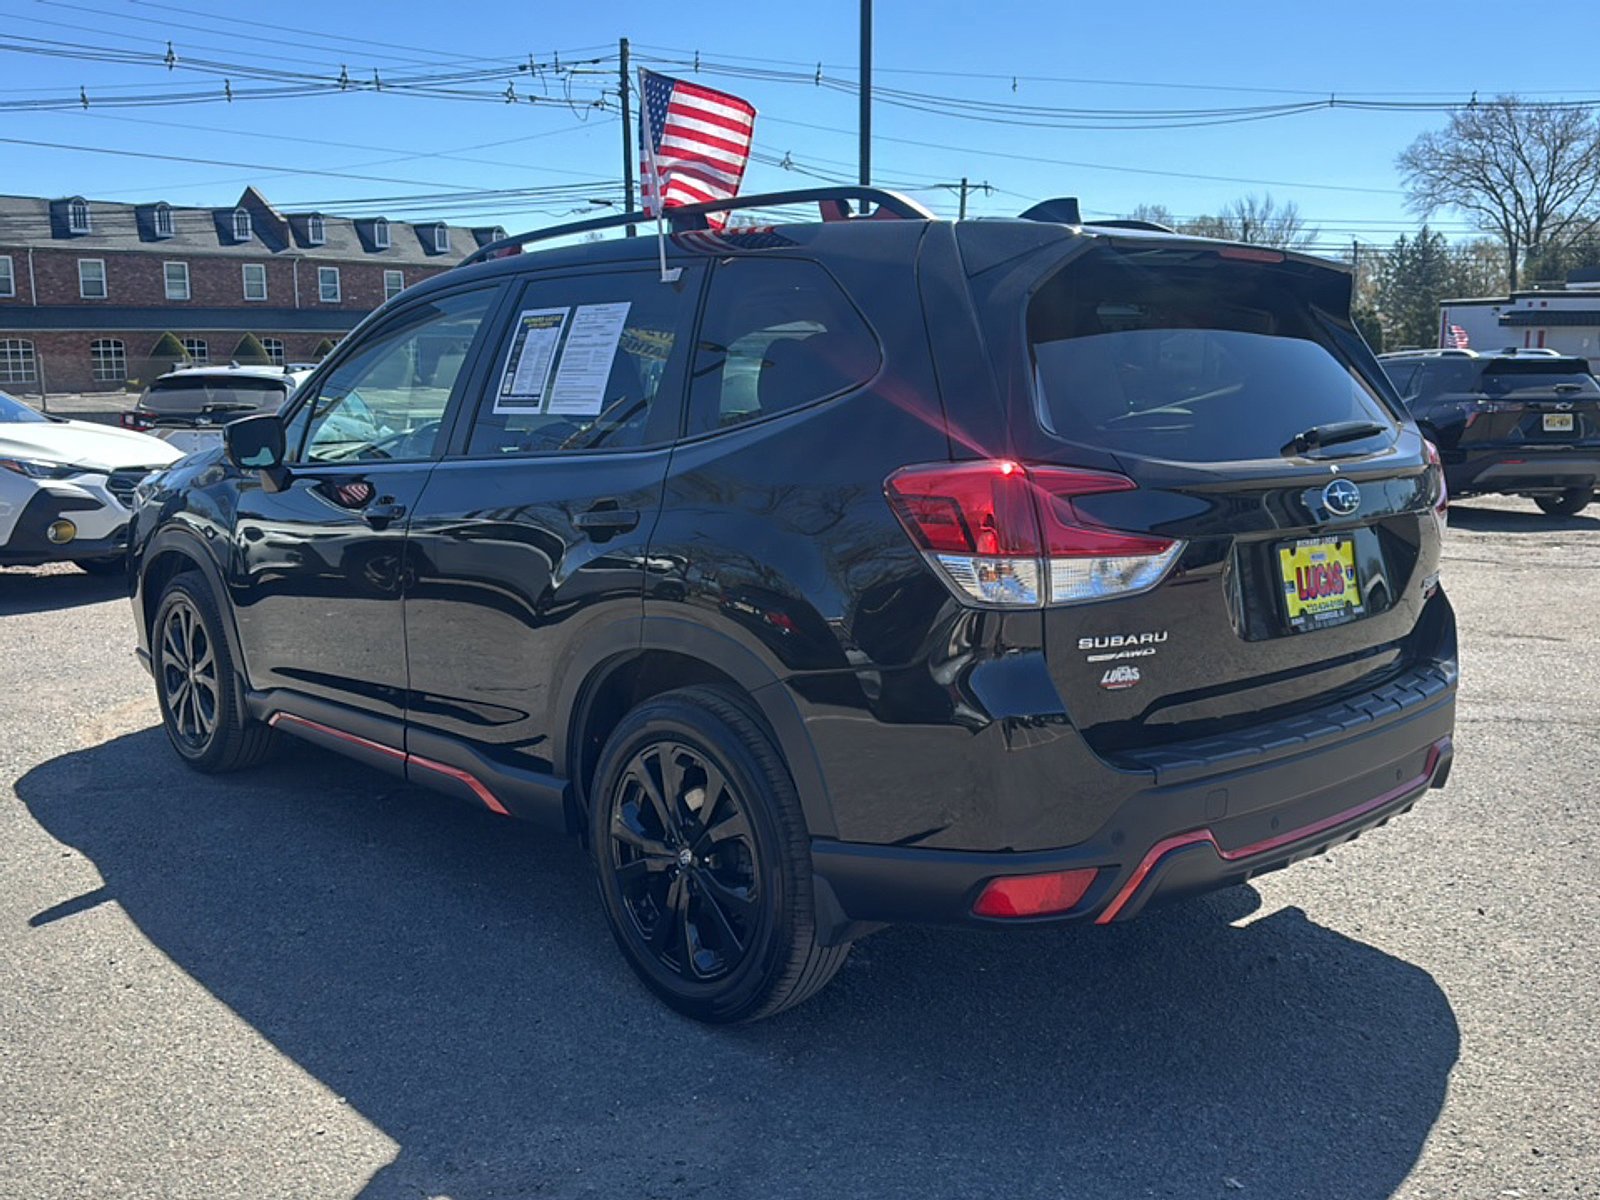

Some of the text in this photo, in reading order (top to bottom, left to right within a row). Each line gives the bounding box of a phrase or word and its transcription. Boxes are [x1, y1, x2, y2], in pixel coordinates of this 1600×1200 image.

[1296, 561, 1345, 601] LUCAS
[1078, 631, 1168, 650] SUBARU
[1101, 665, 1140, 683] LUCAS
